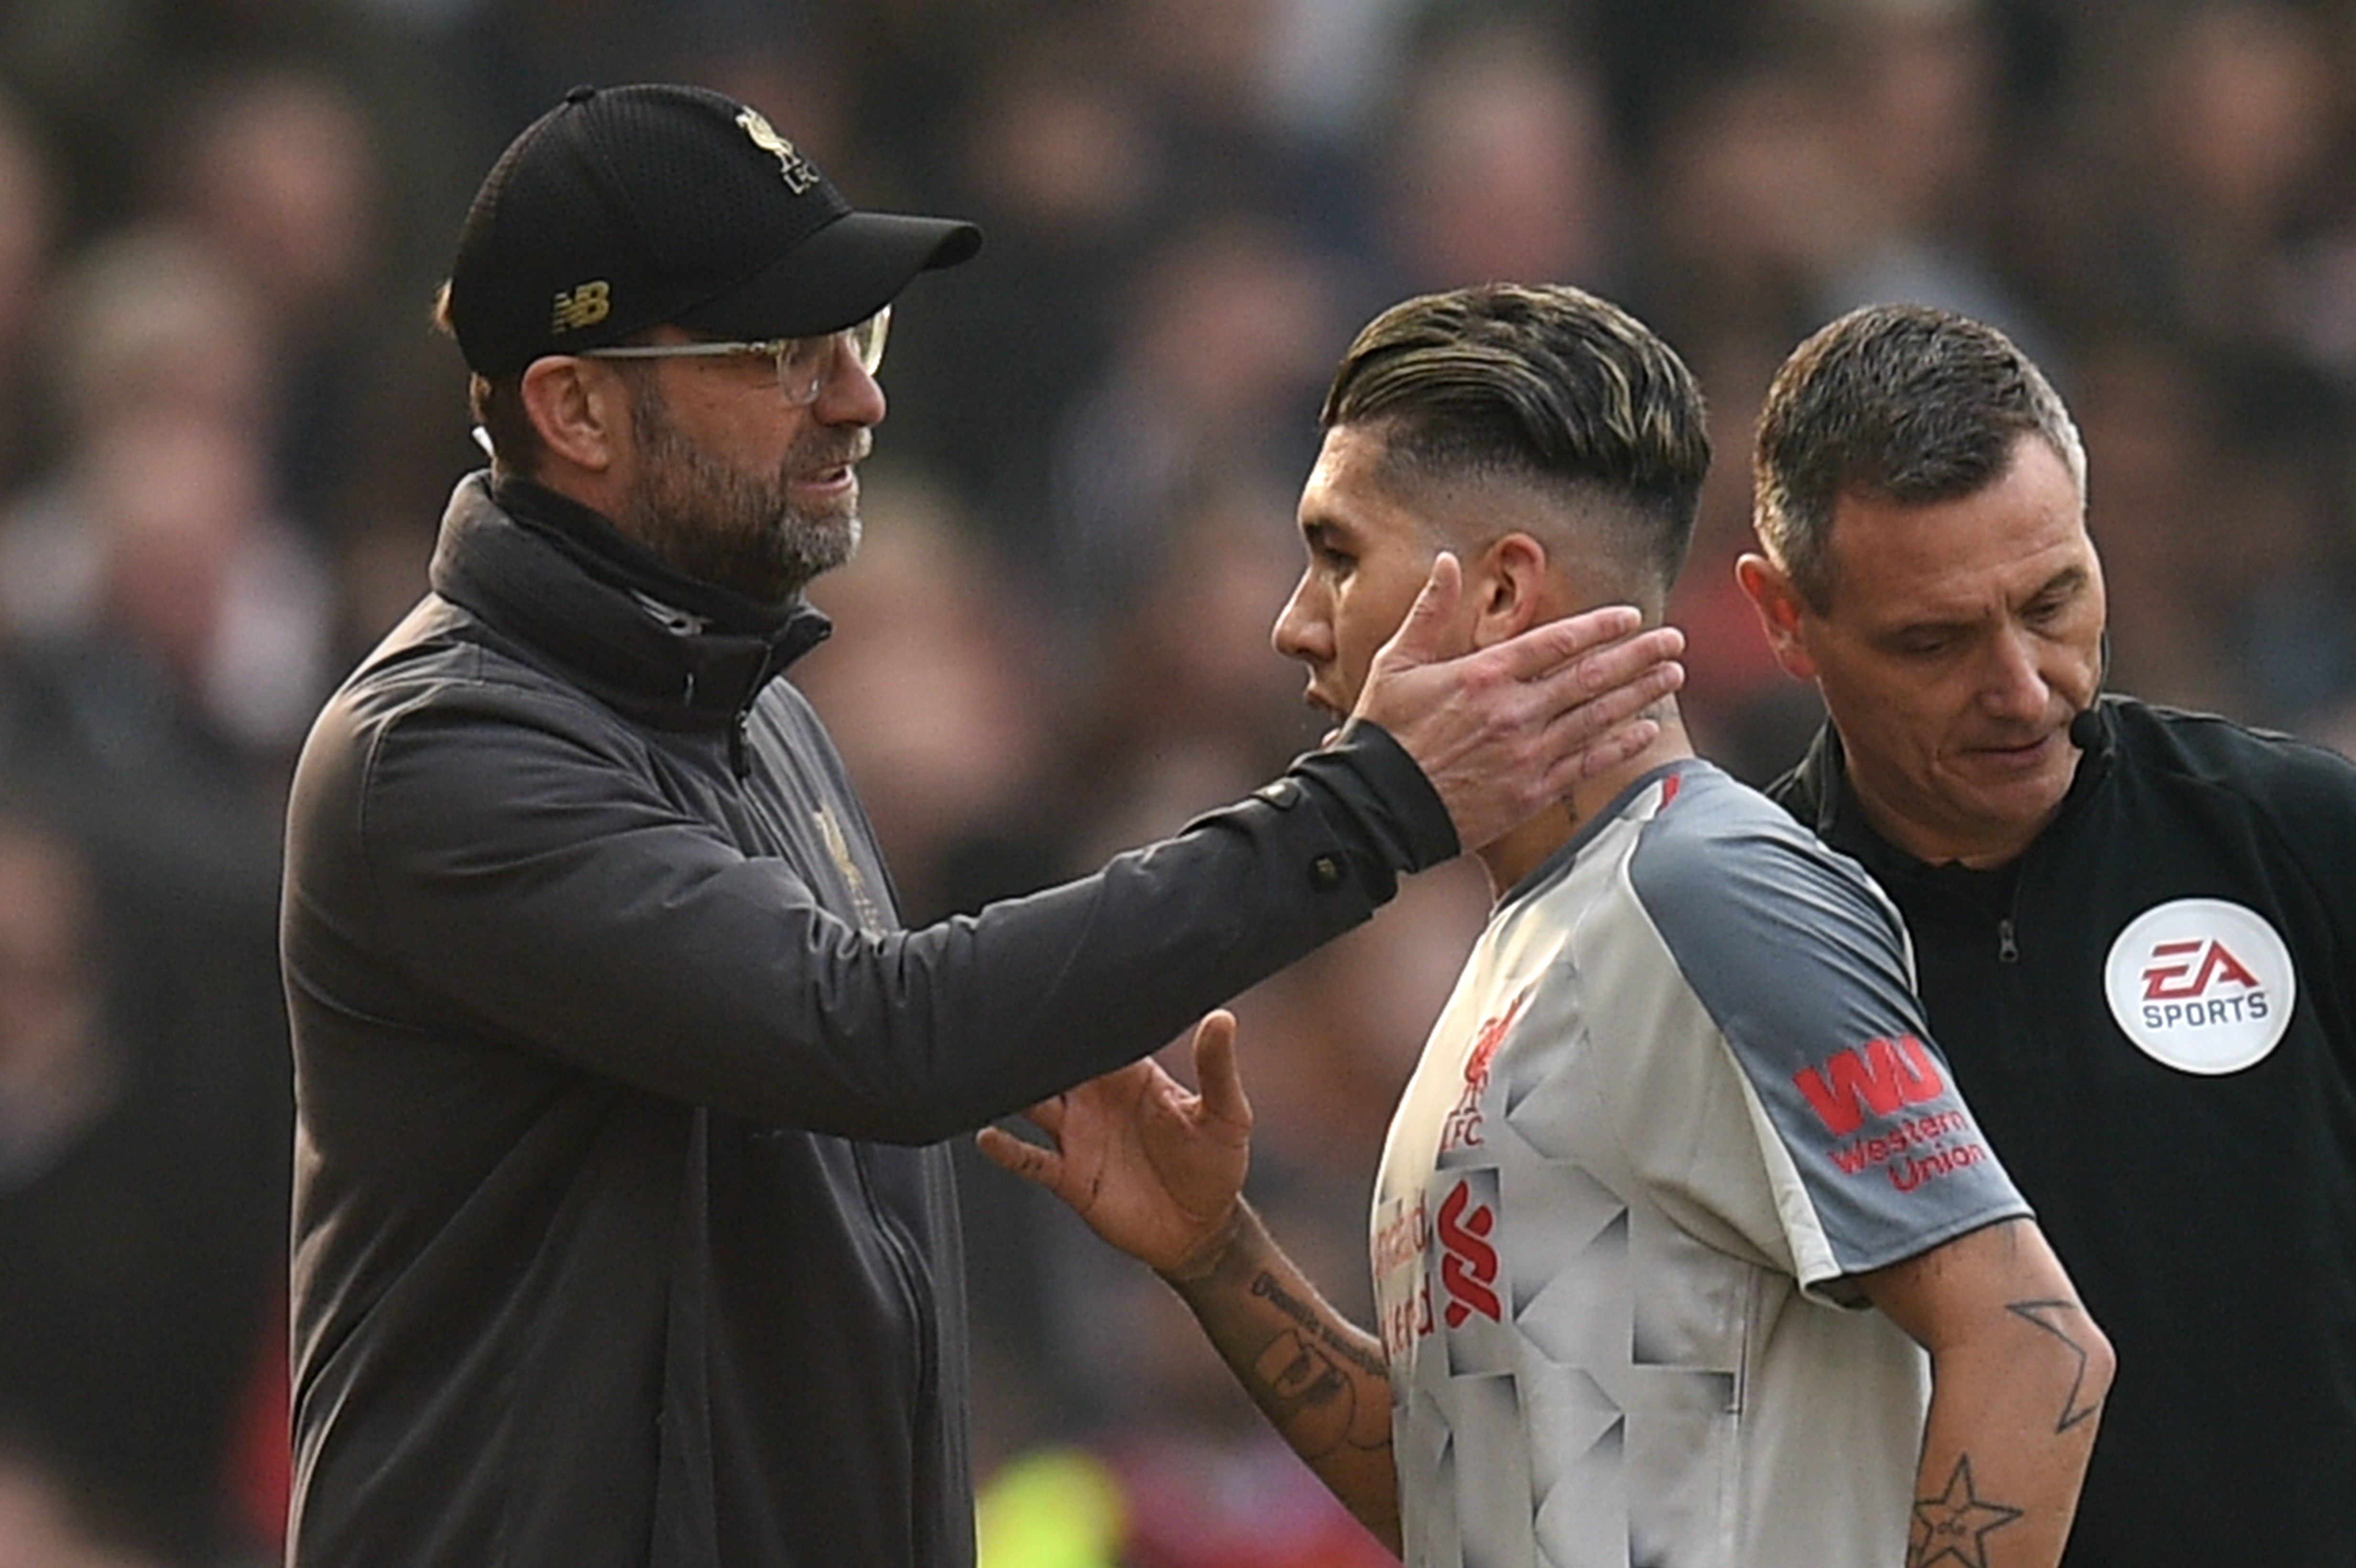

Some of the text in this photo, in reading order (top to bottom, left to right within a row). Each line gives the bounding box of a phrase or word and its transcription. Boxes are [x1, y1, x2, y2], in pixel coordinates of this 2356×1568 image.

[2142, 939, 2260, 1001] EA
[2143, 992, 2268, 1029] SPORTS
[1826, 1110, 1970, 1175] Western
[1888, 1142, 1987, 1193] Union
